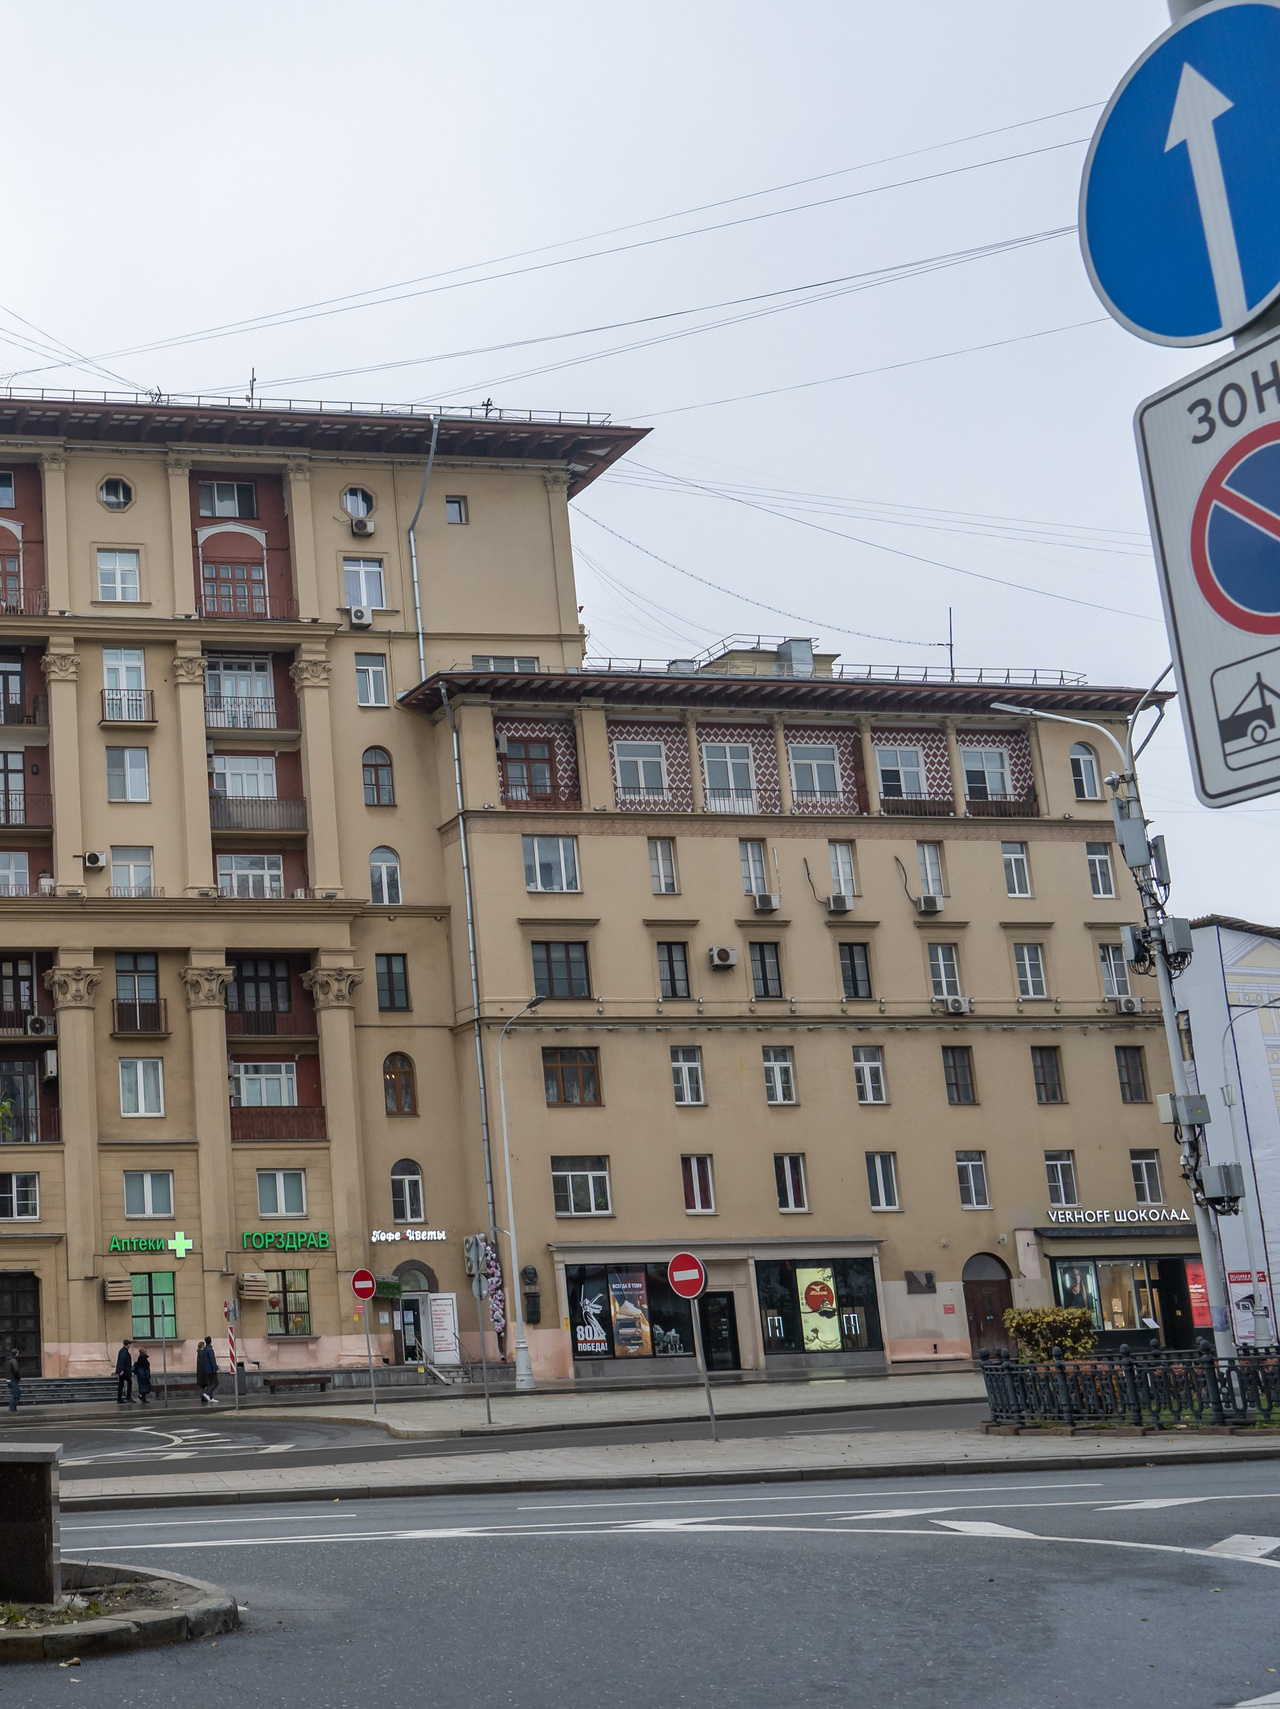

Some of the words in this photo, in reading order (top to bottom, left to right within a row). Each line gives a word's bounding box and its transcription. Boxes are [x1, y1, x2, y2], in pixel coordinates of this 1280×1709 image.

[1048, 1210, 1110, 1223] VERHOFF
[1114, 1208, 1190, 1222] ШОКОЛАД
[242, 1231, 330, 1251] ГОРЗДРАВ
[371, 1230, 401, 1242] Кофе
[406, 1229, 447, 1241] Цветы
[109, 1235, 166, 1252] Аптеки
[1229, 1273, 1265, 1282] ВНИМАЕ
[576, 1325, 594, 1340] 80
[577, 1342, 608, 1352] ПОБЕДА!
